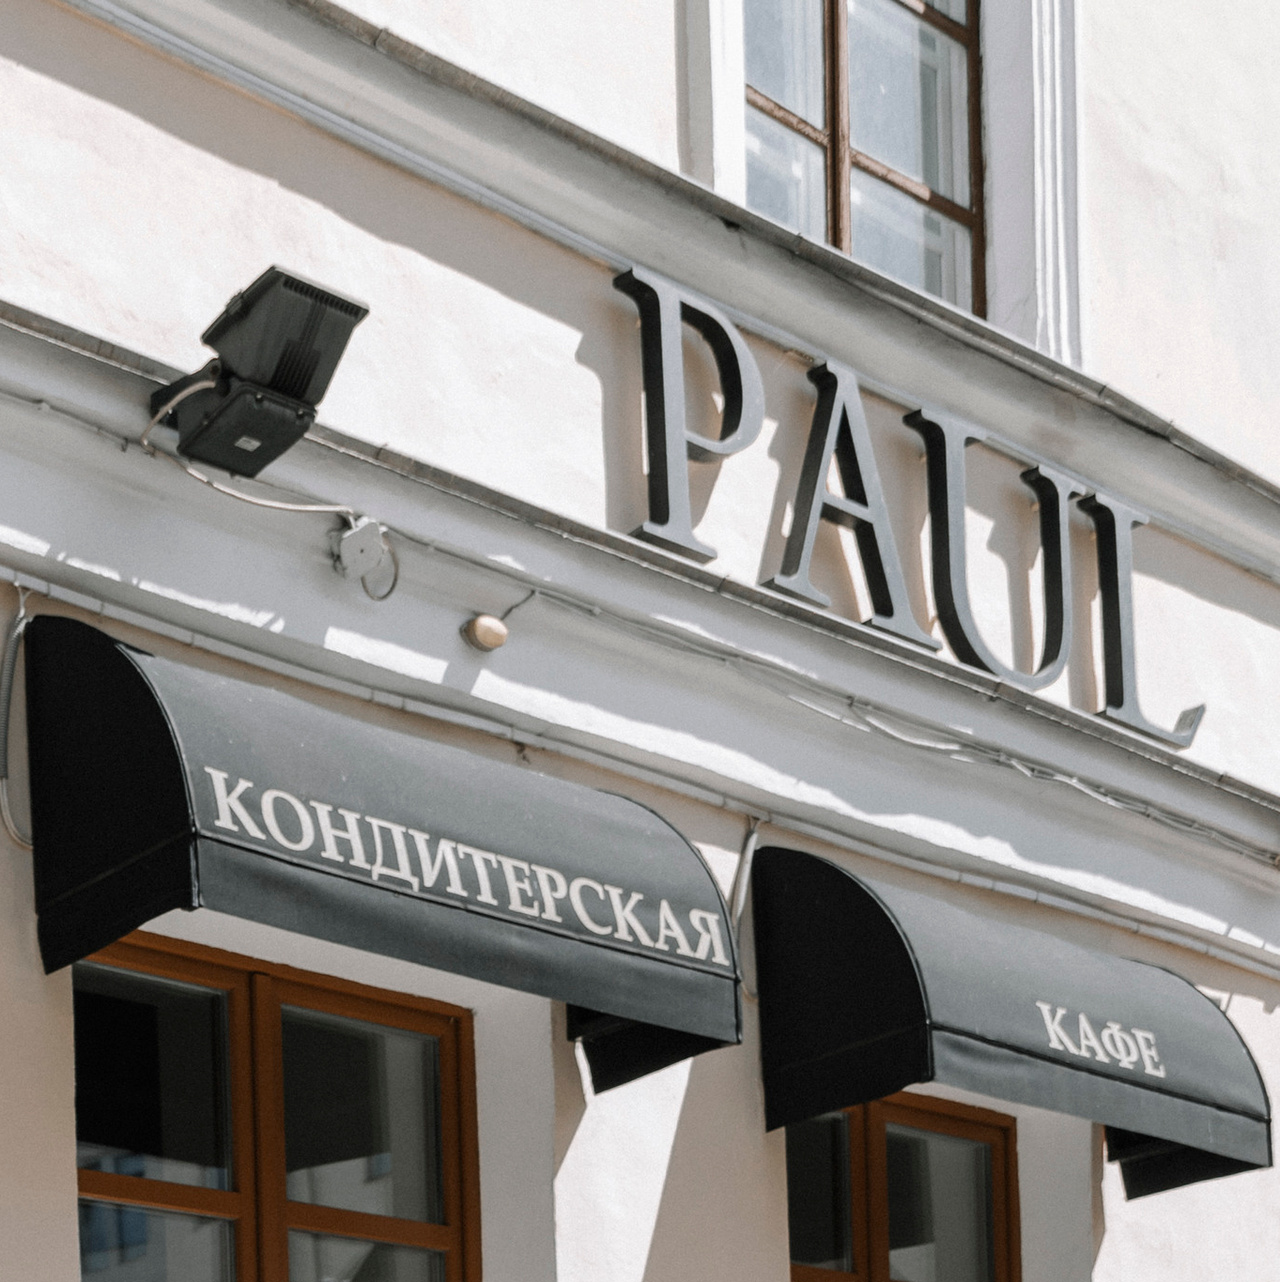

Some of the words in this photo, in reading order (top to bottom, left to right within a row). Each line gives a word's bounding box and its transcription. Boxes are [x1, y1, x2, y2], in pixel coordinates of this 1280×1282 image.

[613, 267, 1206, 751] PAUL
[204, 766, 730, 967] КОНДИТЕРСКАЯ
[1035, 1000, 1166, 1078] КАФЕ
